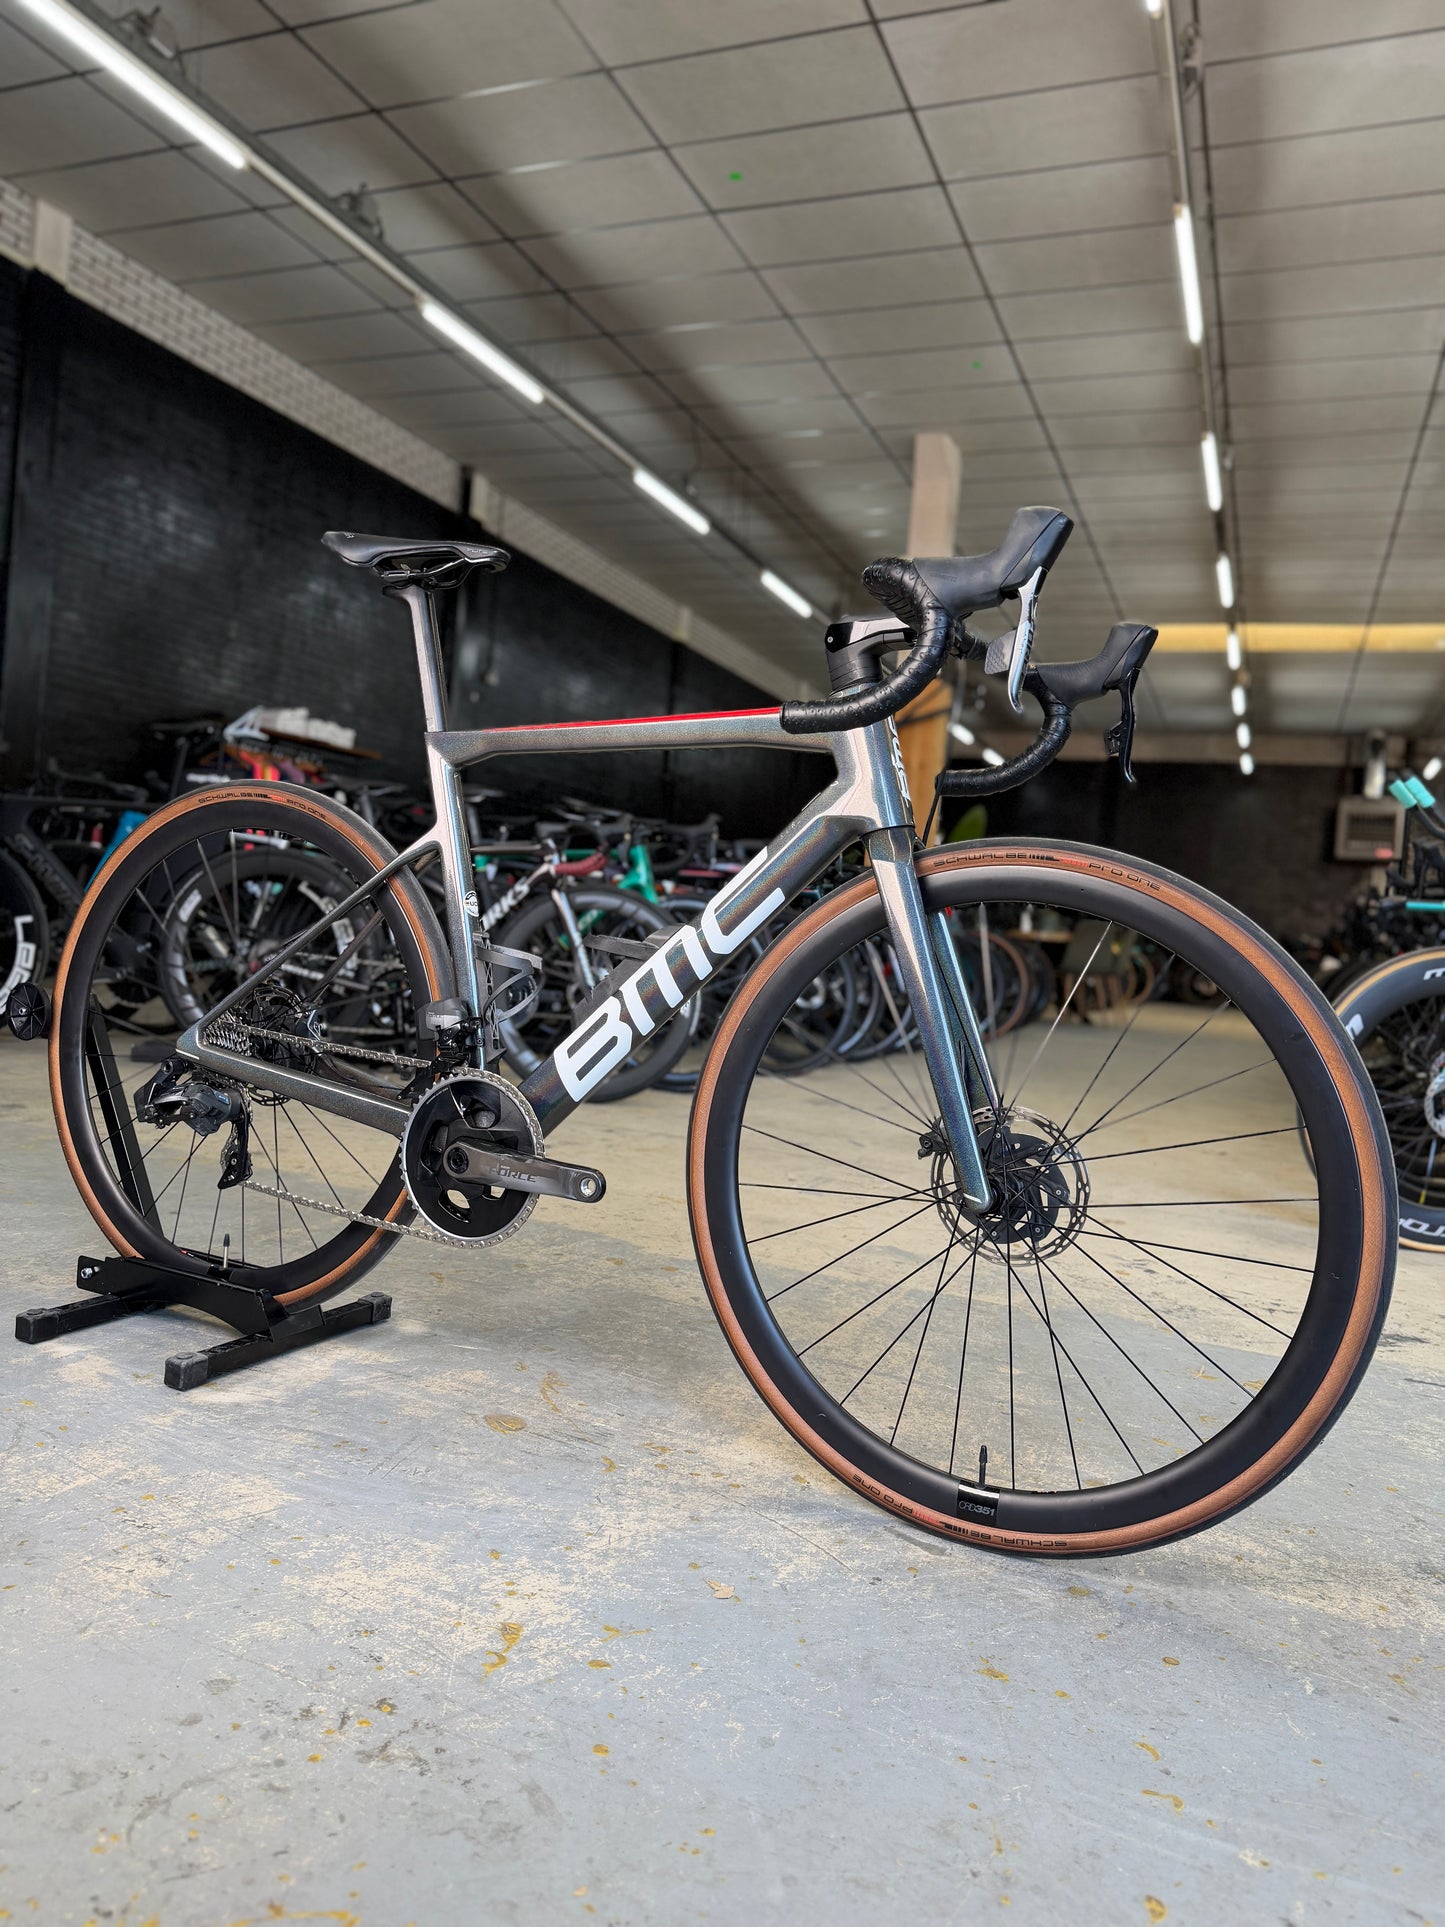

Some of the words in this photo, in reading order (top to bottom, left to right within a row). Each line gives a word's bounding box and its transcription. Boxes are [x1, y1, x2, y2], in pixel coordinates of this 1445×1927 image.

[933, 852, 1028, 868] SCHWALBE
[553, 846, 786, 1102] BMC
[969, 1530, 1068, 1548] SCHWALBE
